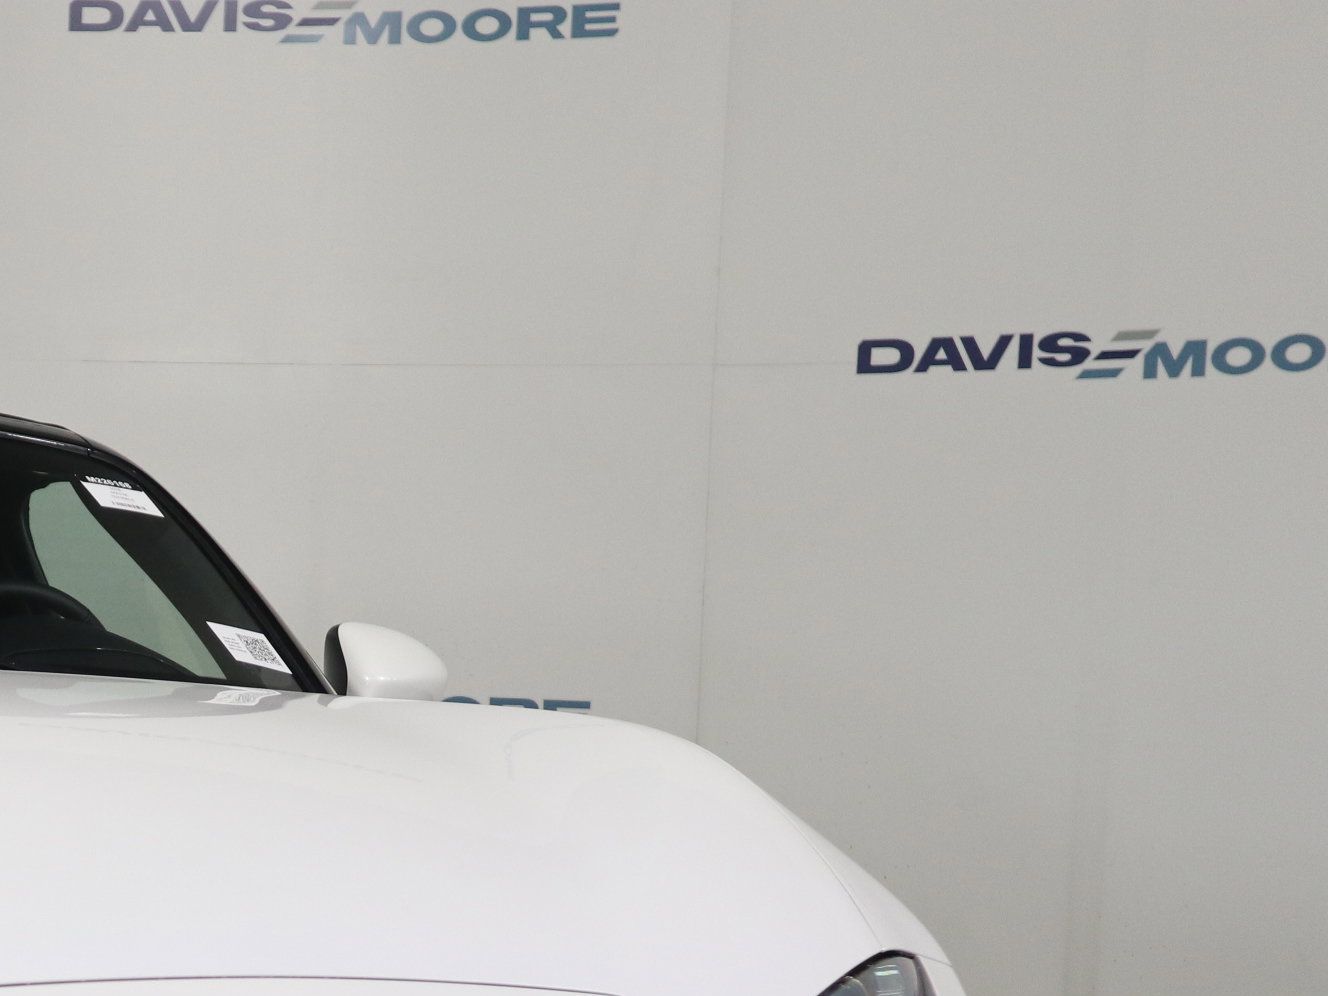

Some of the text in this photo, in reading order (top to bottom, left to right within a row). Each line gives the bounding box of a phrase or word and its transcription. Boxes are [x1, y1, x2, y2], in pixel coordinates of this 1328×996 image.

[68, 0, 621, 45] DAVIS MOORE
[856, 331, 1092, 375] DAVIS
